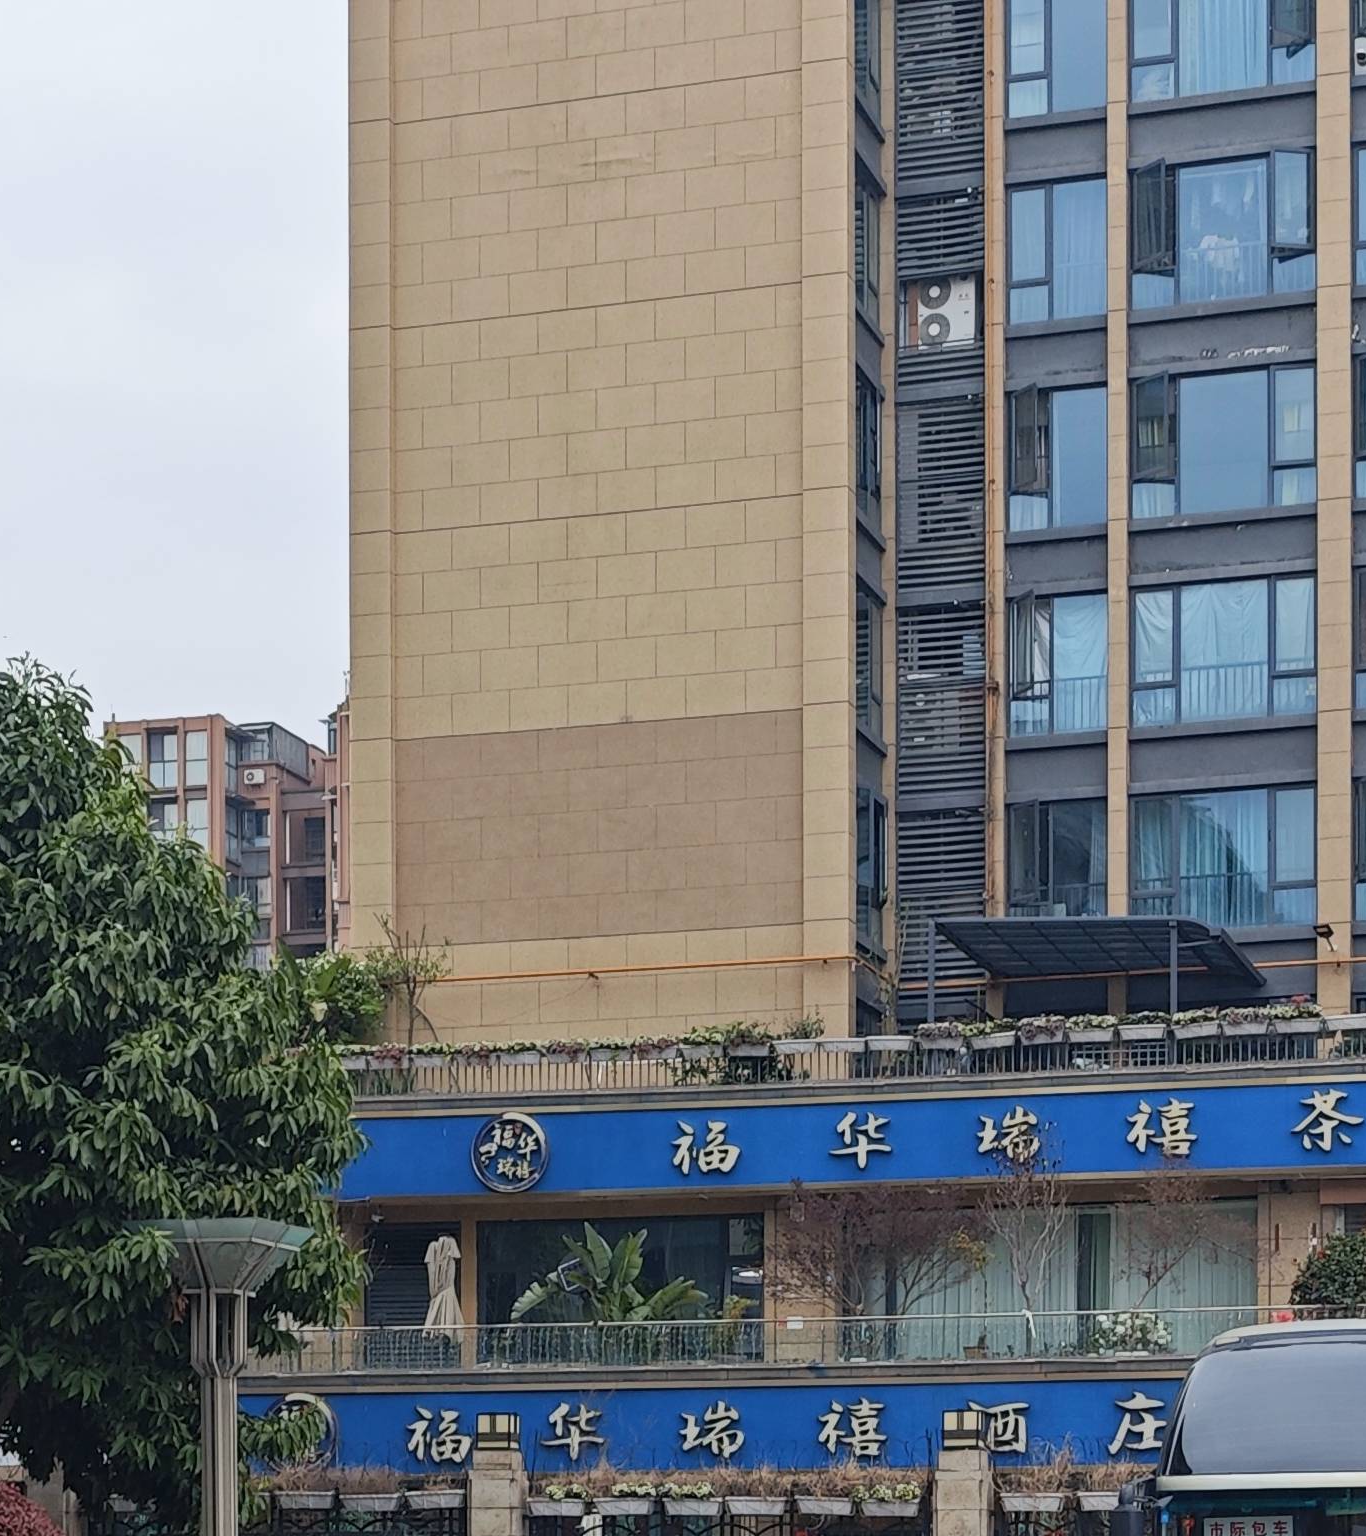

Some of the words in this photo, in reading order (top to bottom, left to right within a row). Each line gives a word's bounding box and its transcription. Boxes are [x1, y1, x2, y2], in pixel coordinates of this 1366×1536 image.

[406, 1391, 1168, 1463] 福华瑞禧酒庄
